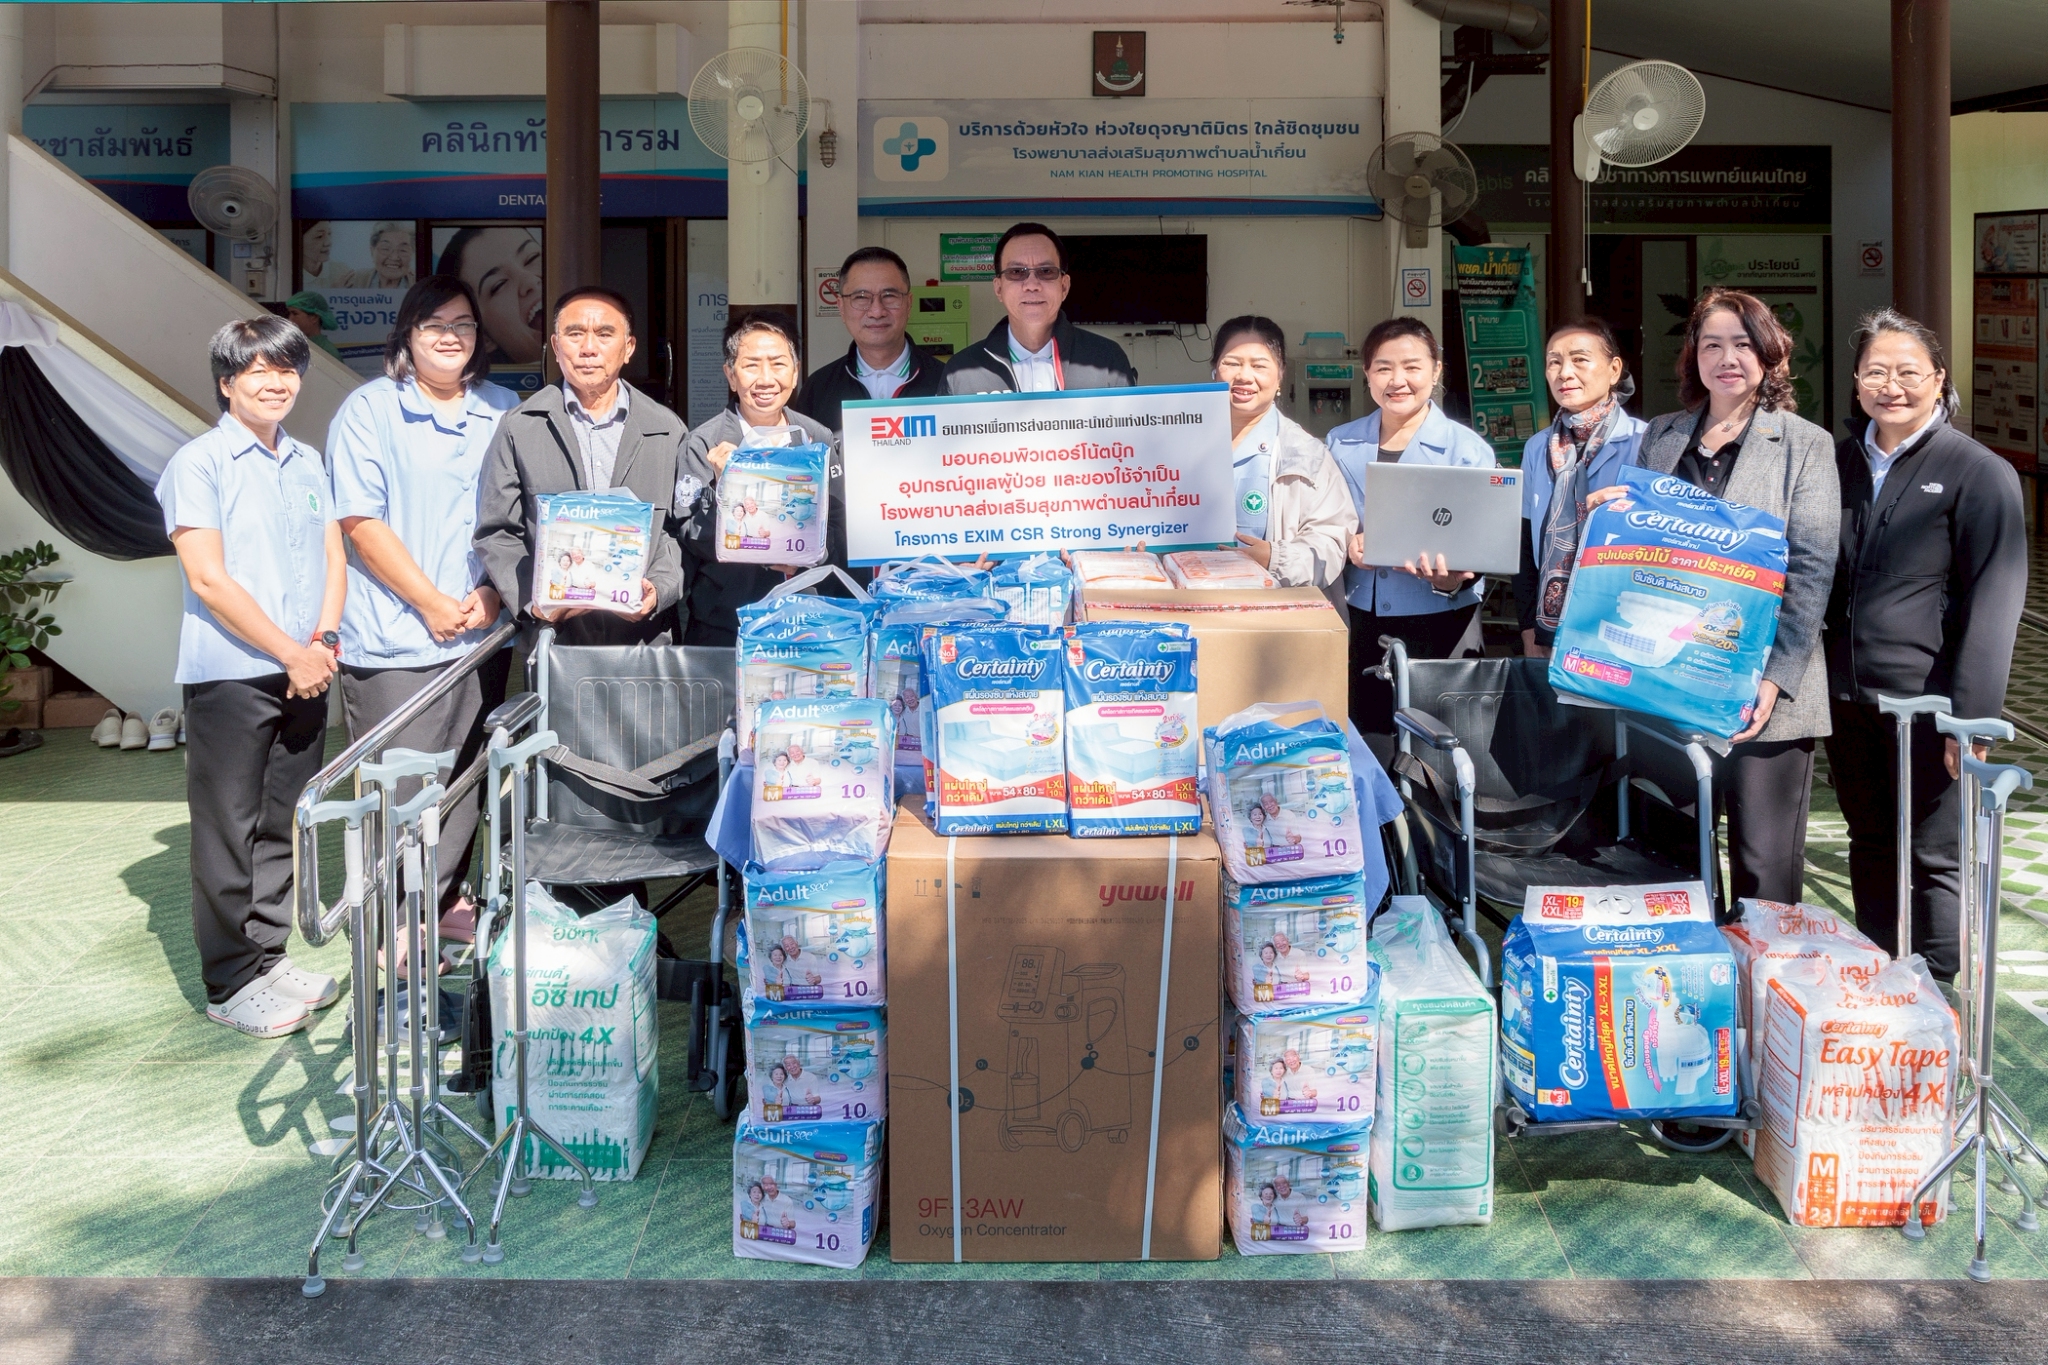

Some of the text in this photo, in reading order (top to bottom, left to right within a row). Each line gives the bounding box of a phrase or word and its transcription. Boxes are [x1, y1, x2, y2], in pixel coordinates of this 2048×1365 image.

[422, 118, 680, 153] คลินิกทักรรม
[959, 119, 1360, 139] บริการด้วยหัวใจ ห่วงใยดุจญาติมิตร ใกล้ชิดชุมชน
[32, 127, 197, 157] ะชาสัมพันธ์
[1050, 170, 1267, 178] NAM KIAN HEALTH PROMOTING HOSPITAL
[1477, 173, 1514, 192] abis
[499, 194, 546, 206] DENTA
[1748, 258, 1800, 270] ประโยชน์
[329, 293, 393, 307] การดูแลฟัน
[1469, 316, 1477, 342] 1
[1473, 364, 1484, 389] 2
[871, 415, 937, 440] EXIM
[942, 412, 1203, 436] ธนาคารเพื่อการส่งออกและนำเข้าแห่งประเทศไทย
[1476, 412, 1488, 437] 3
[872, 438, 912, 447] THAILAND
[942, 442, 1135, 467] มอบคอมพิวเตอร์โน้ตบุ๊ก
[899, 464, 1180, 499] อุปกรณ์ดูแลผู้ป่วย และของใช้จำเป็น
[1490, 475, 1516, 486] EXIM
[557, 504, 600, 520] Adult
[880, 486, 1201, 520] โรงพยาบาลส่งเสริมสุขภาพตำบลน้ำเกี๋ยน
[1433, 507, 1452, 526] hp
[895, 521, 1189, 546] โครงการ EXIM CSR Strong Synergizer
[1627, 510, 1747, 553] Certainty
[727, 539, 738, 549] M
[786, 539, 805, 552] 10
[1596, 547, 1672, 565] ซุปเปอร์จัมโบ้
[552, 589, 564, 600] M
[611, 590, 630, 604] 10
[752, 643, 802, 660] Adult
[941, 647, 957, 658] No.1
[957, 657, 1047, 683] Certainty
[1084, 658, 1175, 683] Certainty
[1564, 657, 1577, 672] M
[1578, 661, 1596, 676] 34
[963, 688, 1039, 700] แผ่นรองซับ แห้งสบาย
[771, 704, 820, 719] Adult
[1235, 741, 1288, 761] Adult
[841, 784, 867, 800] 10
[944, 778, 988, 792] แผ่นใหญ่
[1002, 786, 1037, 797] 54 80
[1073, 781, 1117, 795] แผ่นใหญ่
[766, 790, 779, 802] M
[946, 791, 984, 803] กว่าเดิม
[1075, 794, 1113, 805] กว่าเดิม
[1131, 790, 1167, 799] 54 80
[946, 822, 994, 834] Certainty
[1076, 825, 1121, 837] Certainty
[1322, 838, 1347, 858] 10
[1249, 855, 1263, 867] M
[757, 881, 829, 903] Adult sec
[1544, 895, 1563, 905] XL-
[1566, 896, 1579, 907] 19
[1542, 905, 1563, 917] XXL
[1583, 926, 1665, 945] Certainty
[1637, 944, 1681, 955] XL-XXL
[843, 980, 868, 998] 10
[1329, 975, 1353, 995] 10
[573, 983, 619, 1009] เทป
[769, 989, 782, 1002] M
[1258, 990, 1271, 1002] M
[1598, 974, 1610, 1017] XL-XXL
[579, 1026, 616, 1046] 4X
[1559, 977, 1592, 1089] Certainty
[1623, 1000, 1636, 1068] ซึมซับดี แห้งสบาย
[1820, 1020, 1888, 1038] Certainty
[1820, 1038, 1950, 1073] Easy Tape
[1719, 1059, 1730, 1094] XL-XXL 19
[1904, 1082, 1946, 1105] 4X
[841, 1102, 868, 1120] 10
[1263, 1105, 1276, 1116] M
[1336, 1095, 1360, 1113] 10
[767, 1109, 780, 1122] M
[742, 1126, 793, 1144] Adult
[1254, 1126, 1308, 1146] Adult
[1811, 1156, 1835, 1178] M
[743, 1227, 756, 1240] M
[918, 1223, 1067, 1239] Oxygn Concentrator
[1254, 1229, 1268, 1241] M
[1328, 1223, 1352, 1240] 10
[815, 1232, 841, 1251] 10
